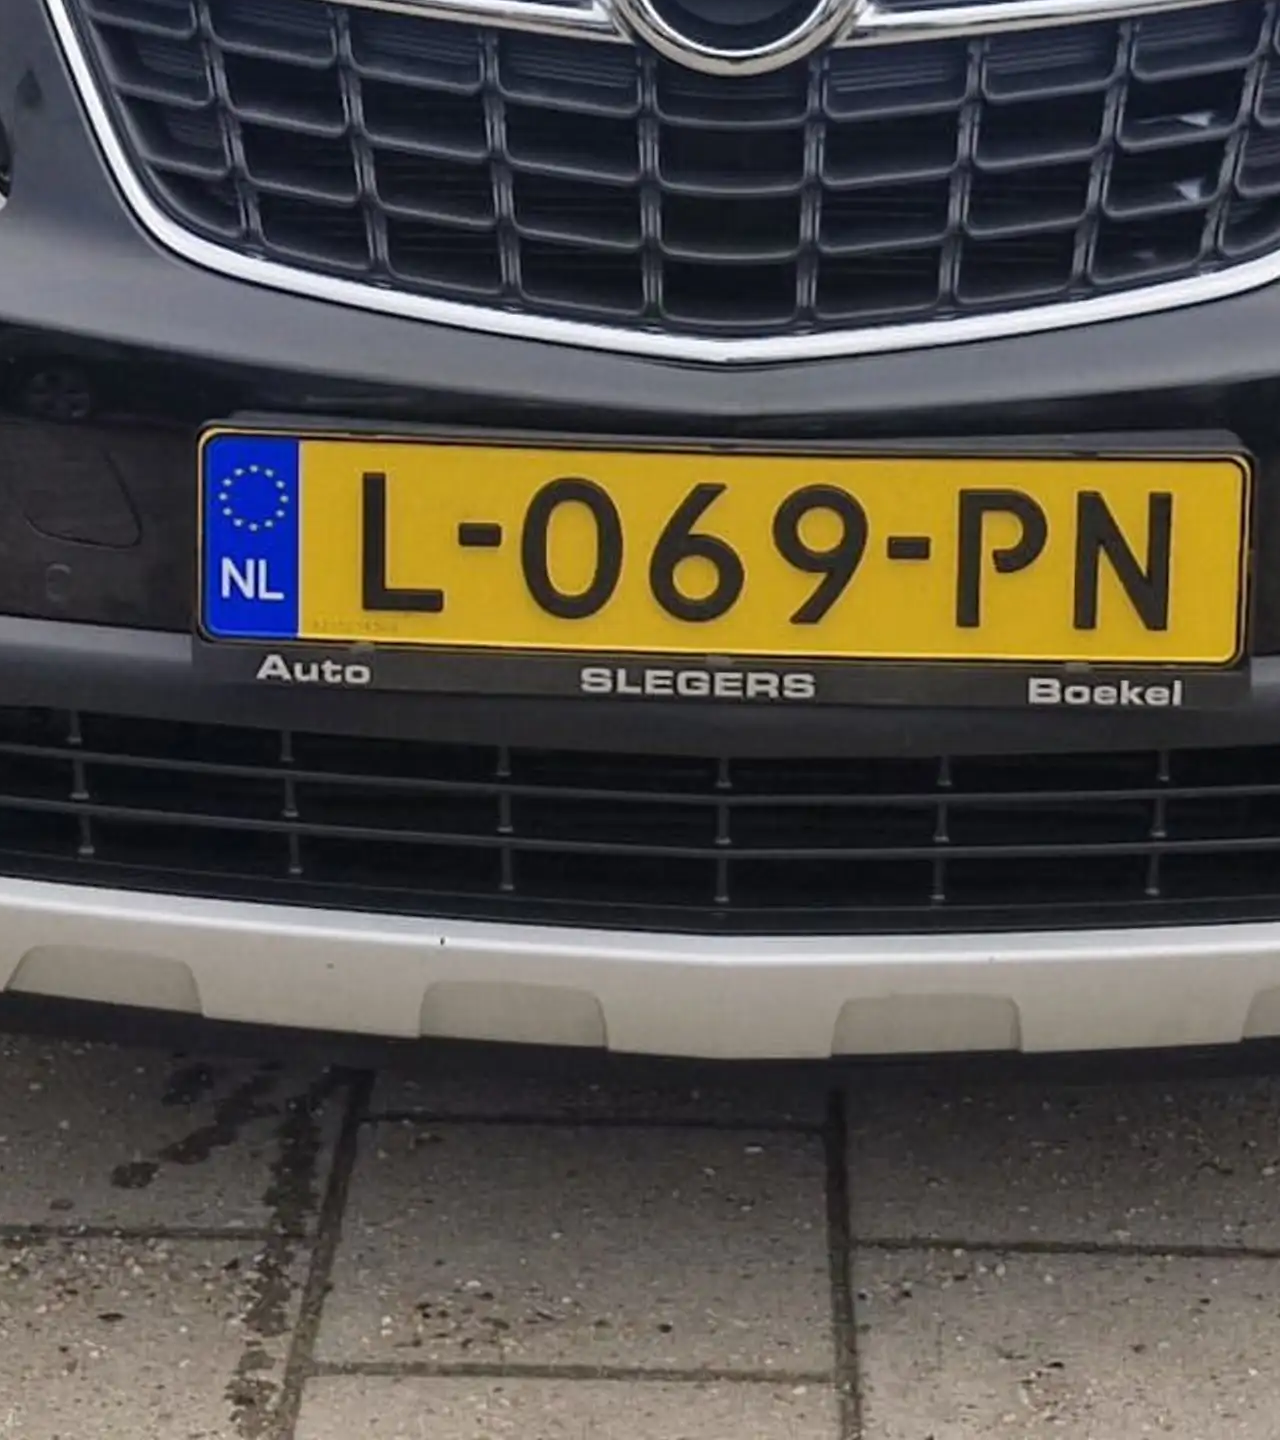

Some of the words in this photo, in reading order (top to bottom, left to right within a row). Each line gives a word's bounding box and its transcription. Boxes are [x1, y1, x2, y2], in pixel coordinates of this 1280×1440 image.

[361, 471, 1173, 632] L-069-PN
[221, 557, 285, 600] NL
[256, 654, 372, 684] Auto
[580, 667, 817, 699] SLEGERS
[1027, 677, 1183, 707] Boekel
